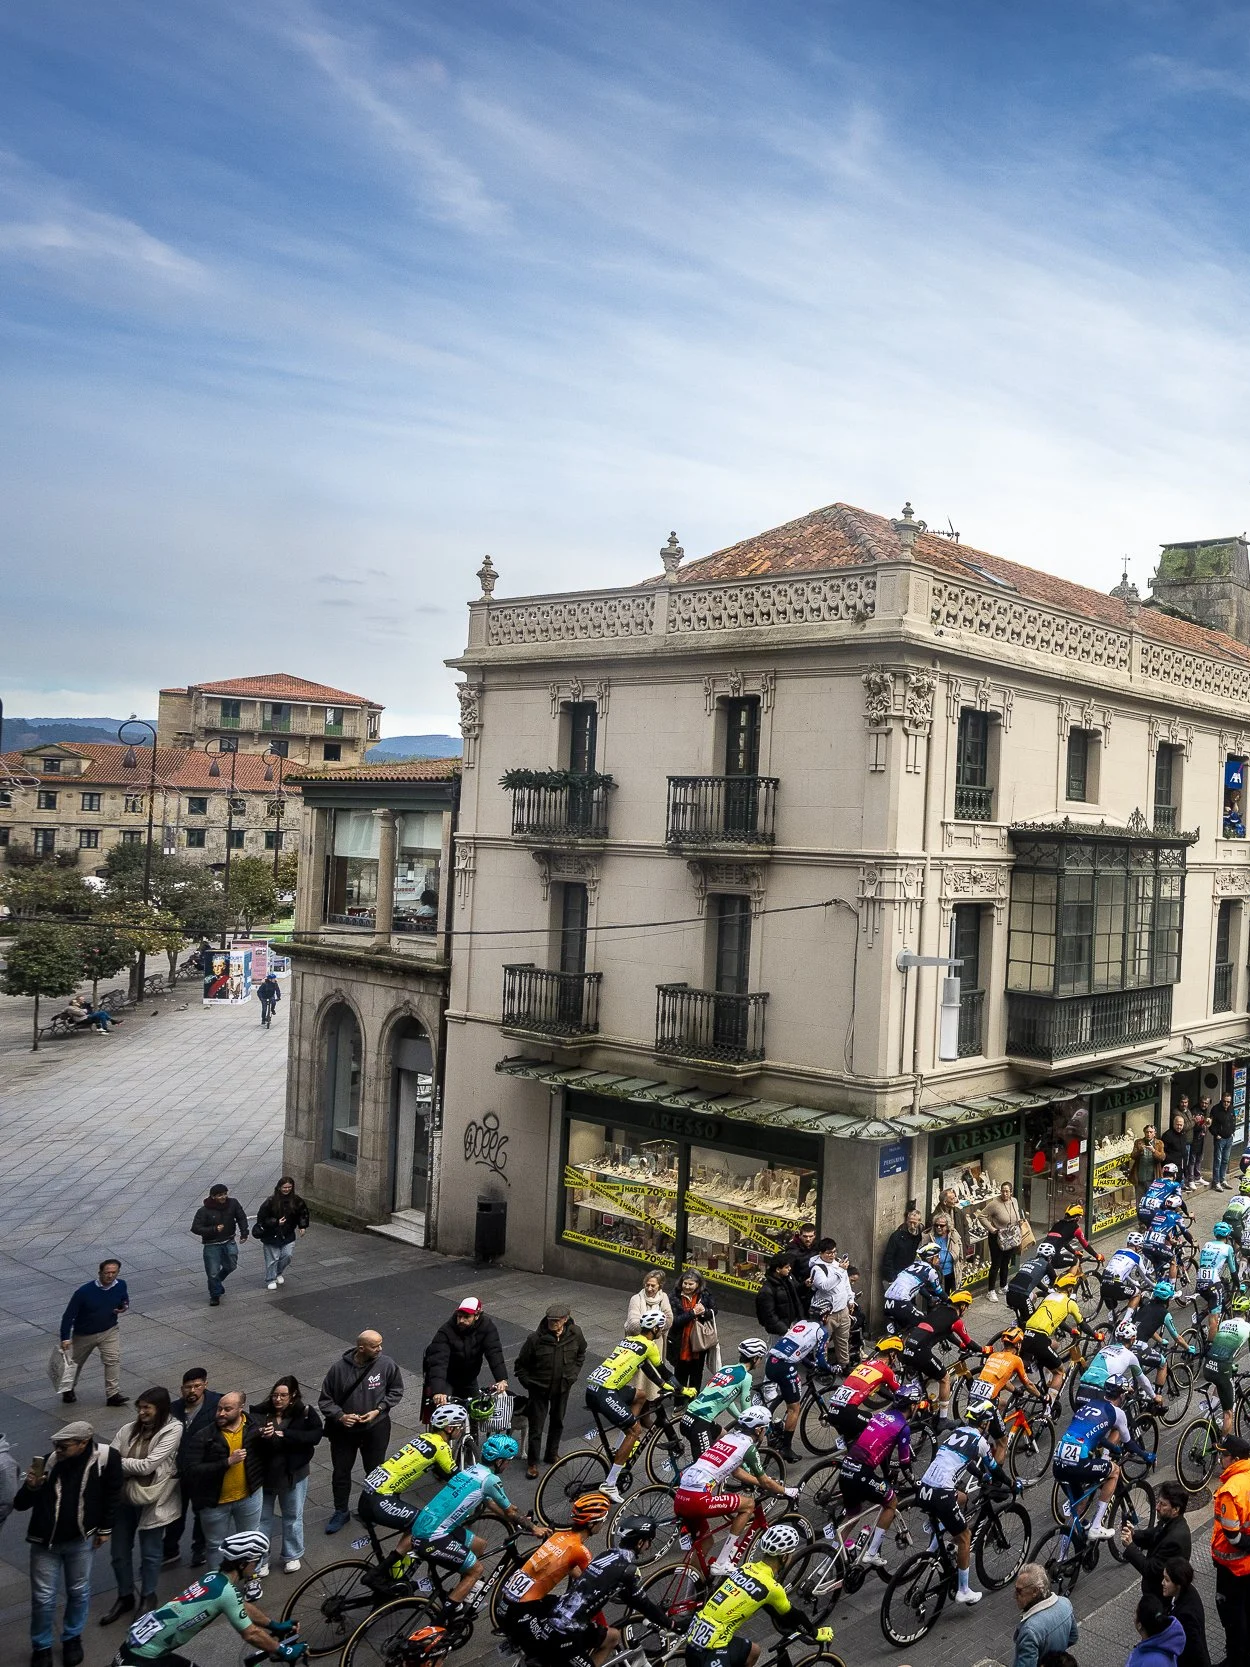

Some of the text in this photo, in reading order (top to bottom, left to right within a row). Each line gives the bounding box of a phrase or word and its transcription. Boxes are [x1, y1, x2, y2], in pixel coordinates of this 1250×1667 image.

[1103, 1086, 1154, 1110] ARESSO
[651, 1113, 720, 1139] ARESSO
[944, 1122, 1014, 1153] ARESSO
[565, 1167, 589, 1186] VACIAMOS
[589, 1182, 619, 1203] ALMACENES
[645, 1215, 664, 1232] 70%
[647, 1187, 667, 1198] 70%
[686, 1193, 713, 1213] VACIAMOS
[714, 1210, 748, 1233] ALMACENES
[1115, 1211, 1130, 1223] 70%
[562, 1231, 586, 1243] VACIAMOS
[587, 1238, 618, 1251] ALMACENES
[644, 1253, 664, 1268] 70%
[711, 1273, 746, 1288] ALMACENES
[1202, 1269, 1212, 1279] 61
[613, 1365, 634, 1386] Somitel
[840, 1388, 852, 1399] 34
[980, 1386, 992, 1396] 97
[605, 1396, 630, 1419] anicolor
[1085, 1420, 1109, 1439] FACTOR
[1065, 1445, 1078, 1461] 24
[389, 1469, 418, 1492] Somitel
[919, 1486, 934, 1501] M
[379, 1499, 415, 1519] anicolor
[472, 1564, 505, 1609] DE ROSA
[509, 1577, 531, 1597] 94
[729, 1569, 762, 1596] nicolor
[692, 1620, 714, 1648] 125
[719, 1613, 746, 1642] Somitel
